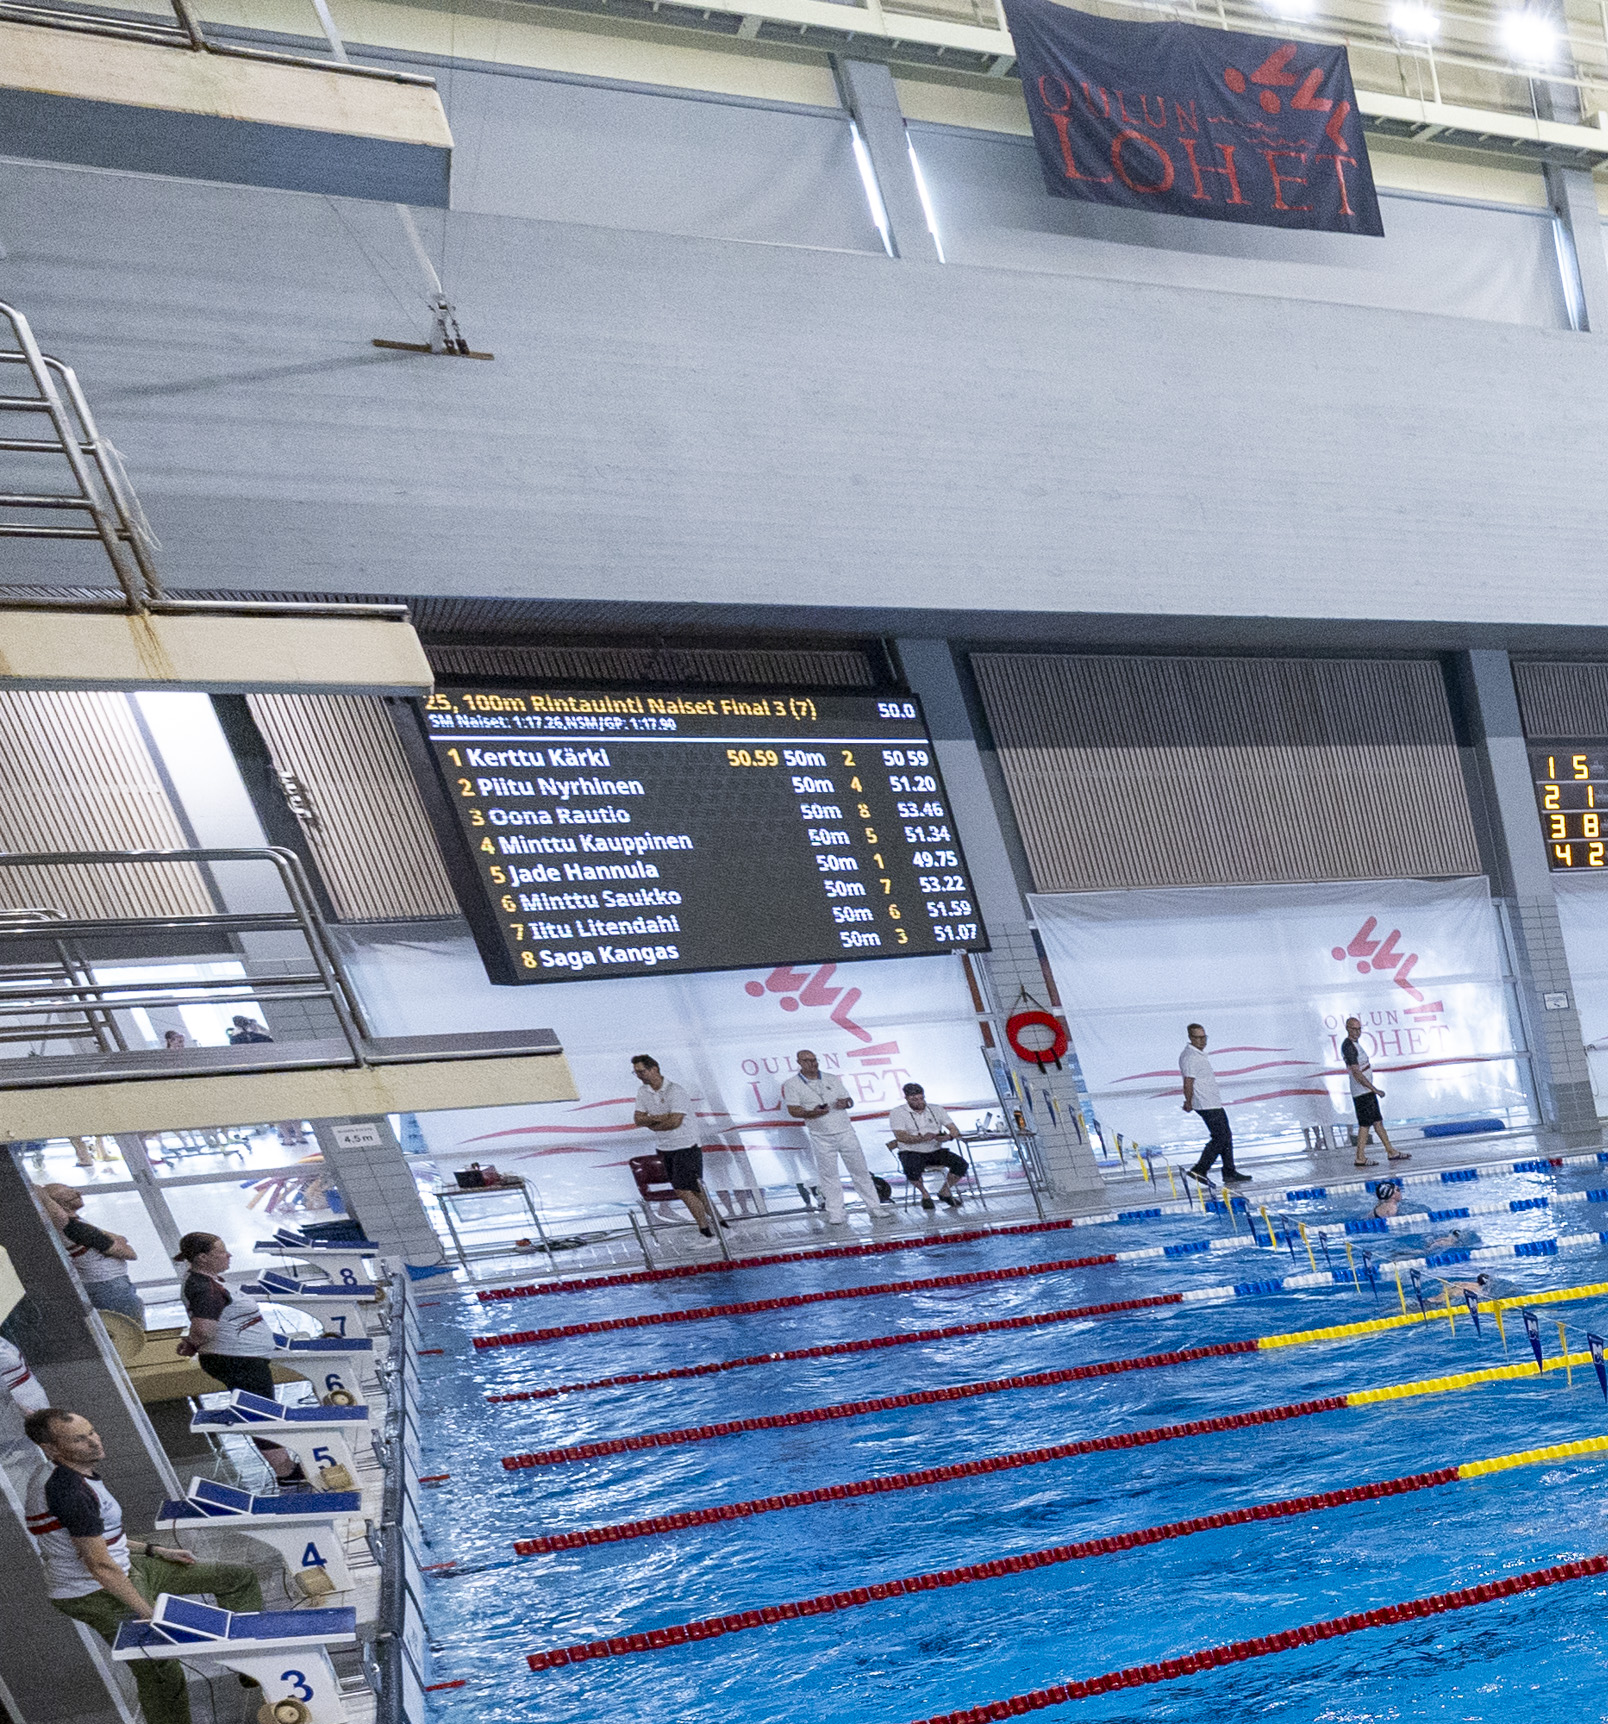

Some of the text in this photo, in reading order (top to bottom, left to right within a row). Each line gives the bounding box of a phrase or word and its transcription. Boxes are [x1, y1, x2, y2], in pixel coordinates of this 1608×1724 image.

[1038, 74, 1199, 133] OULUN
[1043, 111, 1358, 216] LOHET
[462, 694, 527, 712] 100m
[647, 697, 719, 716] Naiset
[721, 697, 768, 717] Final
[774, 700, 787, 717] 3
[789, 697, 818, 721] (7)
[878, 702, 917, 719] 50.0
[427, 713, 454, 729] SM
[447, 747, 463, 768] 1
[465, 747, 546, 768] Kerttu
[547, 746, 611, 768] Kärki
[726, 749, 779, 768] 50.59
[783, 749, 827, 768] 50m
[841, 750, 856, 767] 2
[1547, 755, 1556, 780] 1
[1571, 754, 1590, 780] 5
[457, 775, 937, 801] 2 Piitu Nyrhinen 50m 4 51.20
[1543, 784, 1561, 810] 2
[1586, 784, 1595, 808] 1
[468, 801, 944, 827] 3 Oona Rautio 50m 8 53.46
[1549, 813, 1567, 840] 3
[1582, 812, 1600, 838] 8
[480, 824, 952, 856] 4 Minttu Kauppinen 50m 5 51.34
[1554, 842, 1573, 868] 4
[1588, 840, 1605, 867] 2
[489, 850, 959, 888] 5 Jade Hannula 50m 1 49.75
[500, 874, 967, 913] 6 Minttu Saukko 50m 7 53.22
[509, 922, 525, 941] 7
[831, 905, 875, 923] 50m
[887, 903, 902, 920] 6
[925, 899, 973, 918] 51.59
[520, 923, 979, 971] 8 Saga Kangas 50m 3 51.07
[741, 1052, 841, 1077] OULN
[748, 1068, 911, 1114] LET
[340, 1267, 358, 1287] 8
[330, 1314, 349, 1337] 7
[325, 1373, 344, 1394] 6
[312, 1445, 338, 1471] 5
[300, 1542, 328, 1568] 4
[279, 1668, 315, 1704] 3
